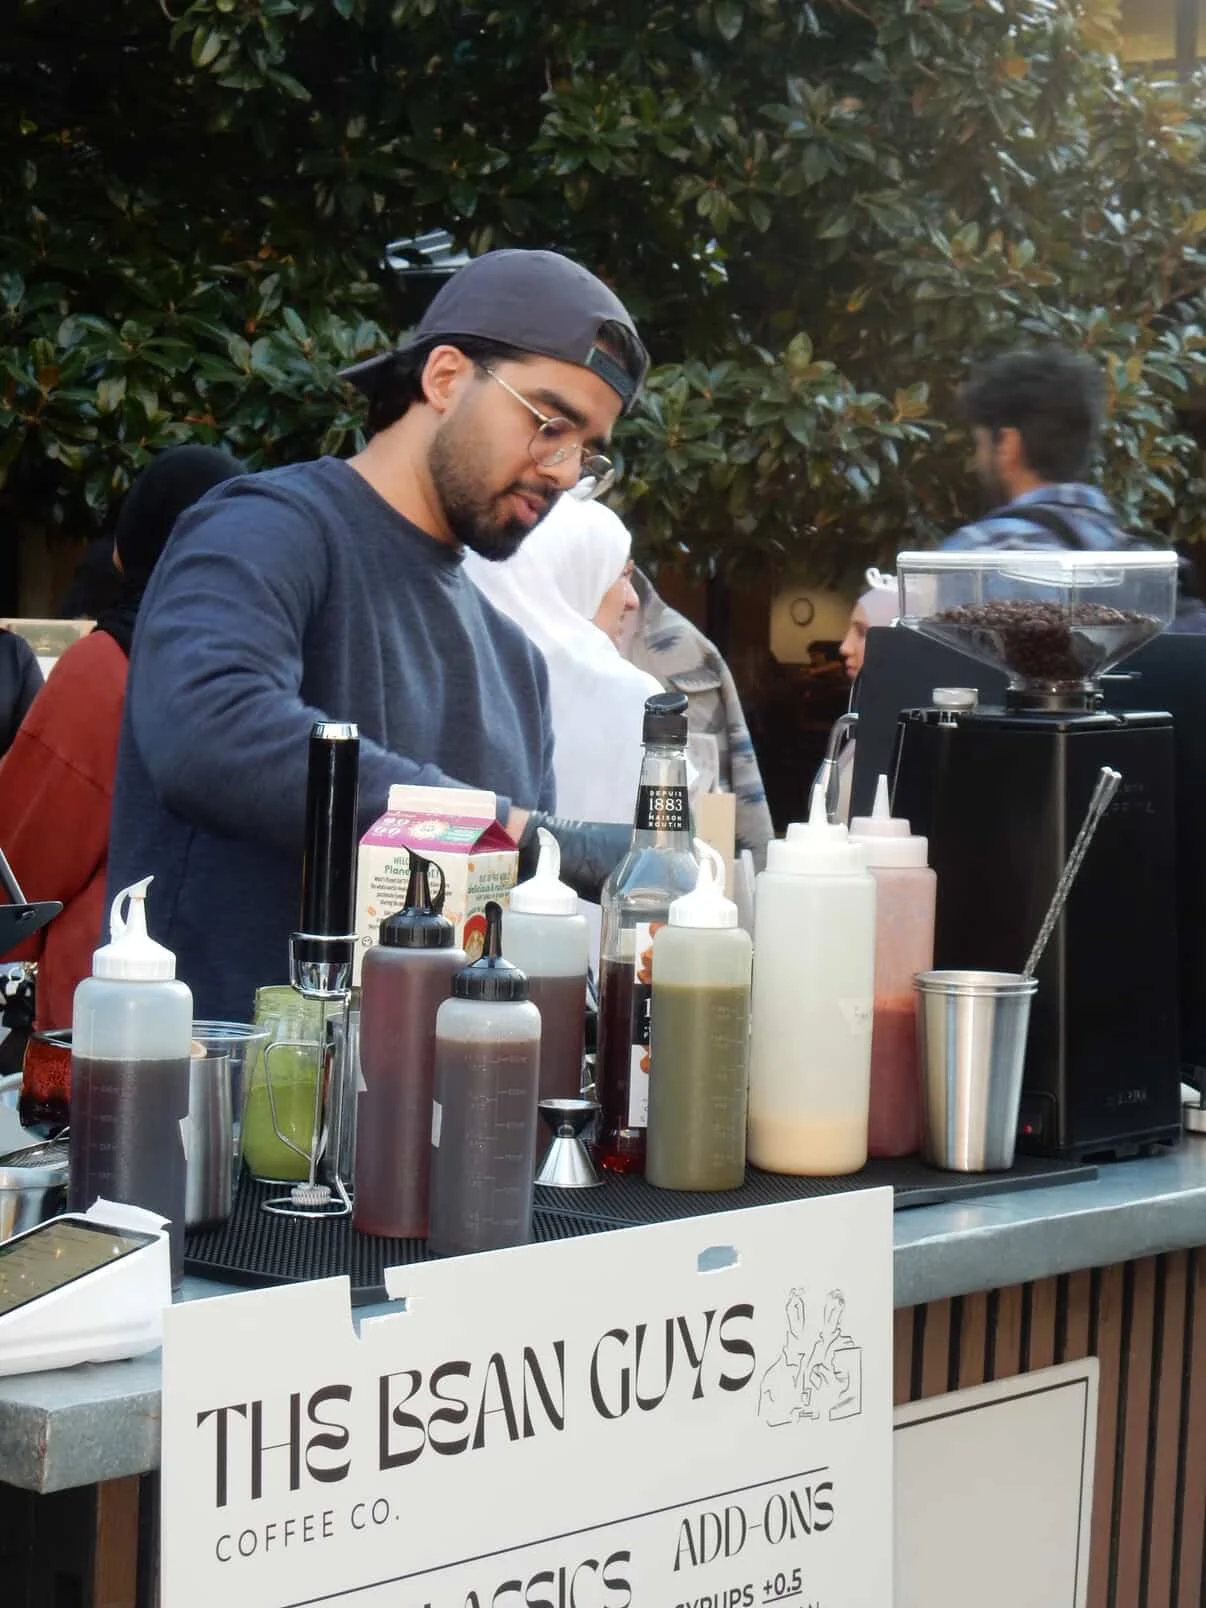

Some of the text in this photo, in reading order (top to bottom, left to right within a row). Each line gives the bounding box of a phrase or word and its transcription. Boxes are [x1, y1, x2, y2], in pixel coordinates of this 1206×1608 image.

[648, 813, 682, 821] MAISON
[649, 798, 682, 811] 1883
[197, 1303, 756, 1508] THE BEAN GUYS
[216, 1498, 400, 1562] COFFEE CO.
[673, 1481, 834, 1572] ADD-ONS
[763, 1567, 803, 1597] +0.5
